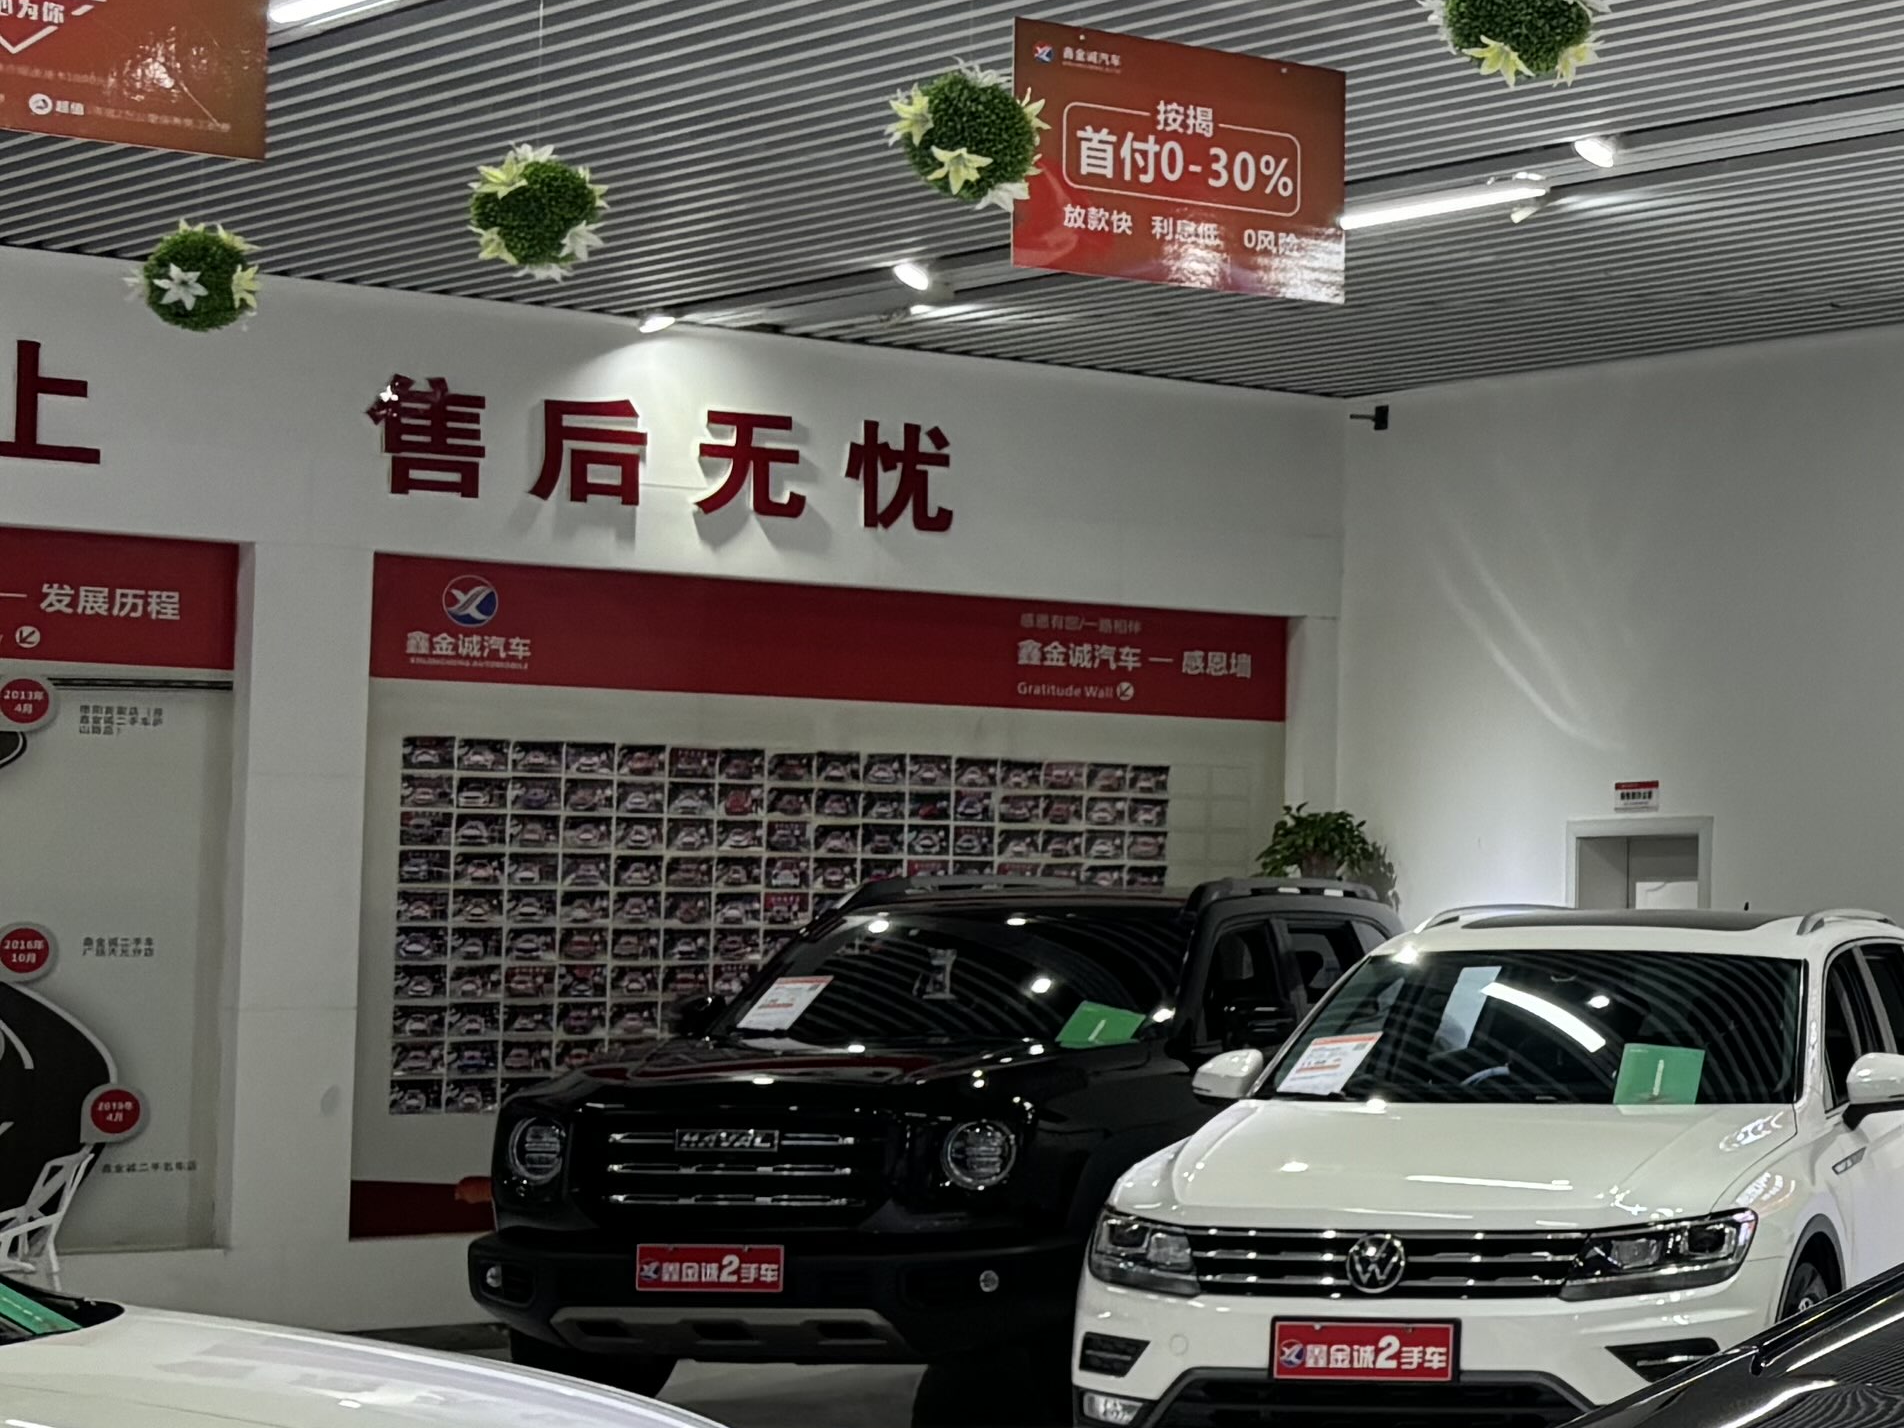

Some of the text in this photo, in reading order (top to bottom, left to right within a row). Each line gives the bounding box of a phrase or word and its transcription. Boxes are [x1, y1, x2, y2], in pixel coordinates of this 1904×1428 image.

[1156, 100, 1214, 137] 按揭
[1076, 125, 1294, 198] 首付0-30%
[1063, 204, 1132, 235] 放款快
[1151, 216, 1222, 247] 利息低
[367, 373, 954, 532] 售后无忧
[40, 583, 181, 620] 发展历程
[406, 631, 532, 659] 鑫金诚汽车
[1017, 639, 1252, 679] 鑫金诚汽车 感恩墙
[1017, 681, 1114, 699] Gratitude Wall
[680, 1131, 773, 1148] HAVAL
[1305, 1335, 1448, 1370] 鑫金诚2手车
